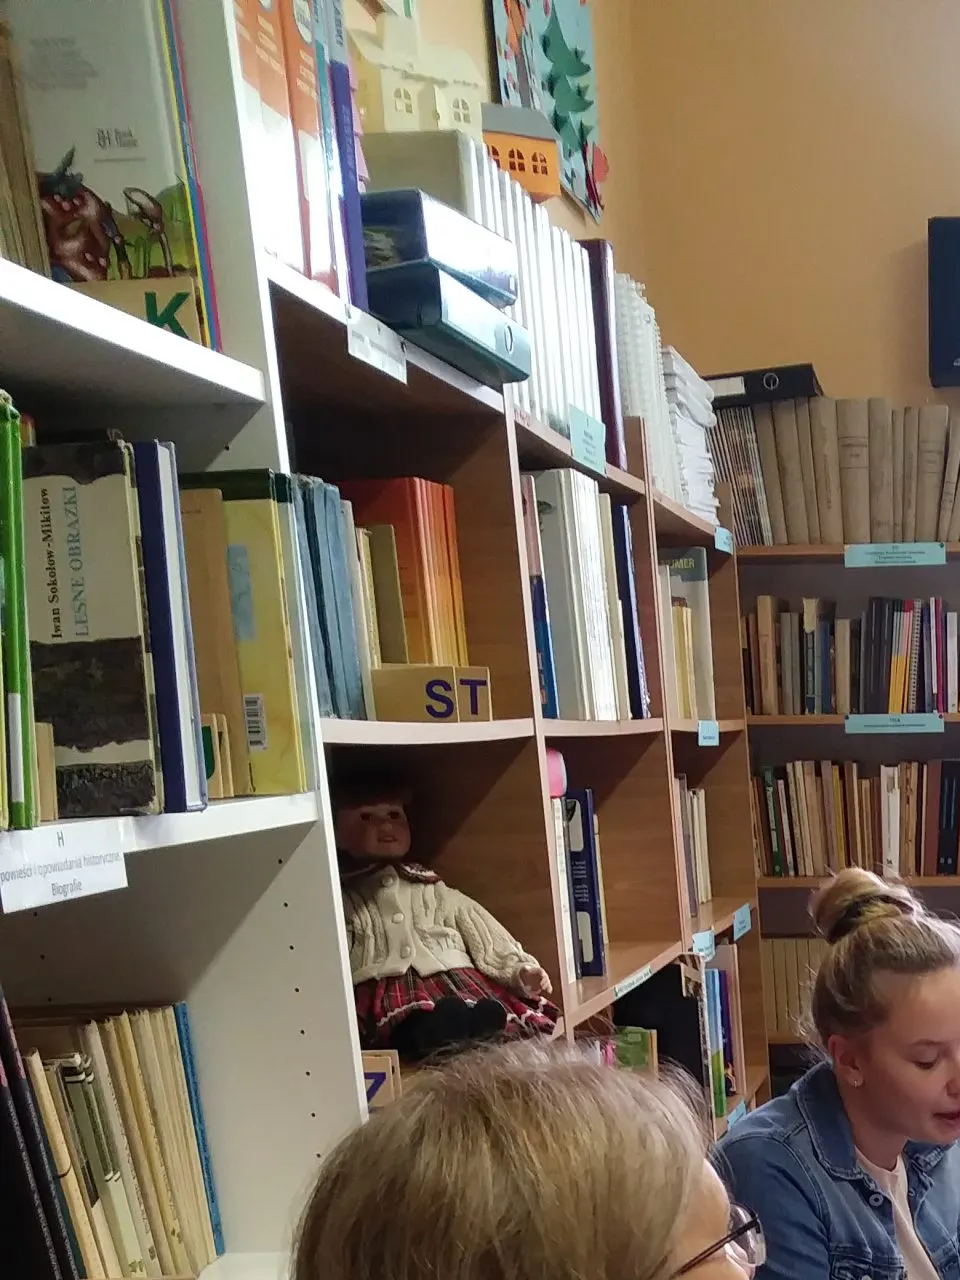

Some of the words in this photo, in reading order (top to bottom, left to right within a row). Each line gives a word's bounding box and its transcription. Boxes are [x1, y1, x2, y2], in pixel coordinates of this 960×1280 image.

[144, 291, 190, 339] K
[62, 486, 83, 572] OBRAZKI
[52, 607, 62, 639] Iwan
[426, 679, 454, 718] S
[460, 678, 487, 715] T
[57, 830, 64, 847] H
[51, 878, 82, 896] Biografie
